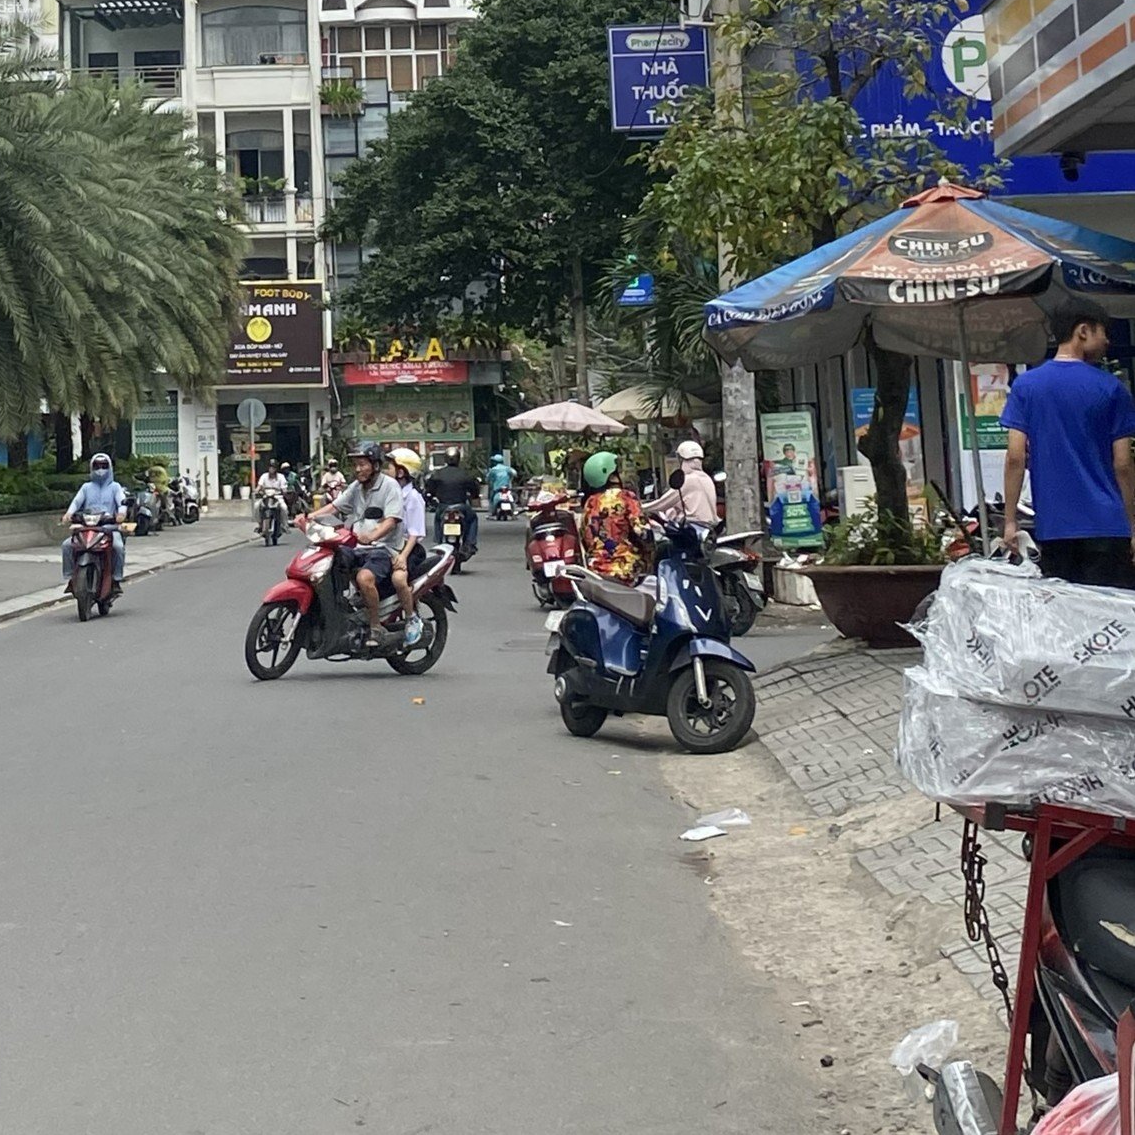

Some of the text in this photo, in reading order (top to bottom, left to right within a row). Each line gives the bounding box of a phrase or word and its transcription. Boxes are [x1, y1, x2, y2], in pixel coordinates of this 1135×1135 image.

[641, 56, 679, 76] NHÀ
[894, 233, 986, 251] CHIN-SU
[254, 288, 312, 301] FOOT BODY
[888, 276, 1001, 304] CHIN-SU
[262, 303, 297, 316] ANH
